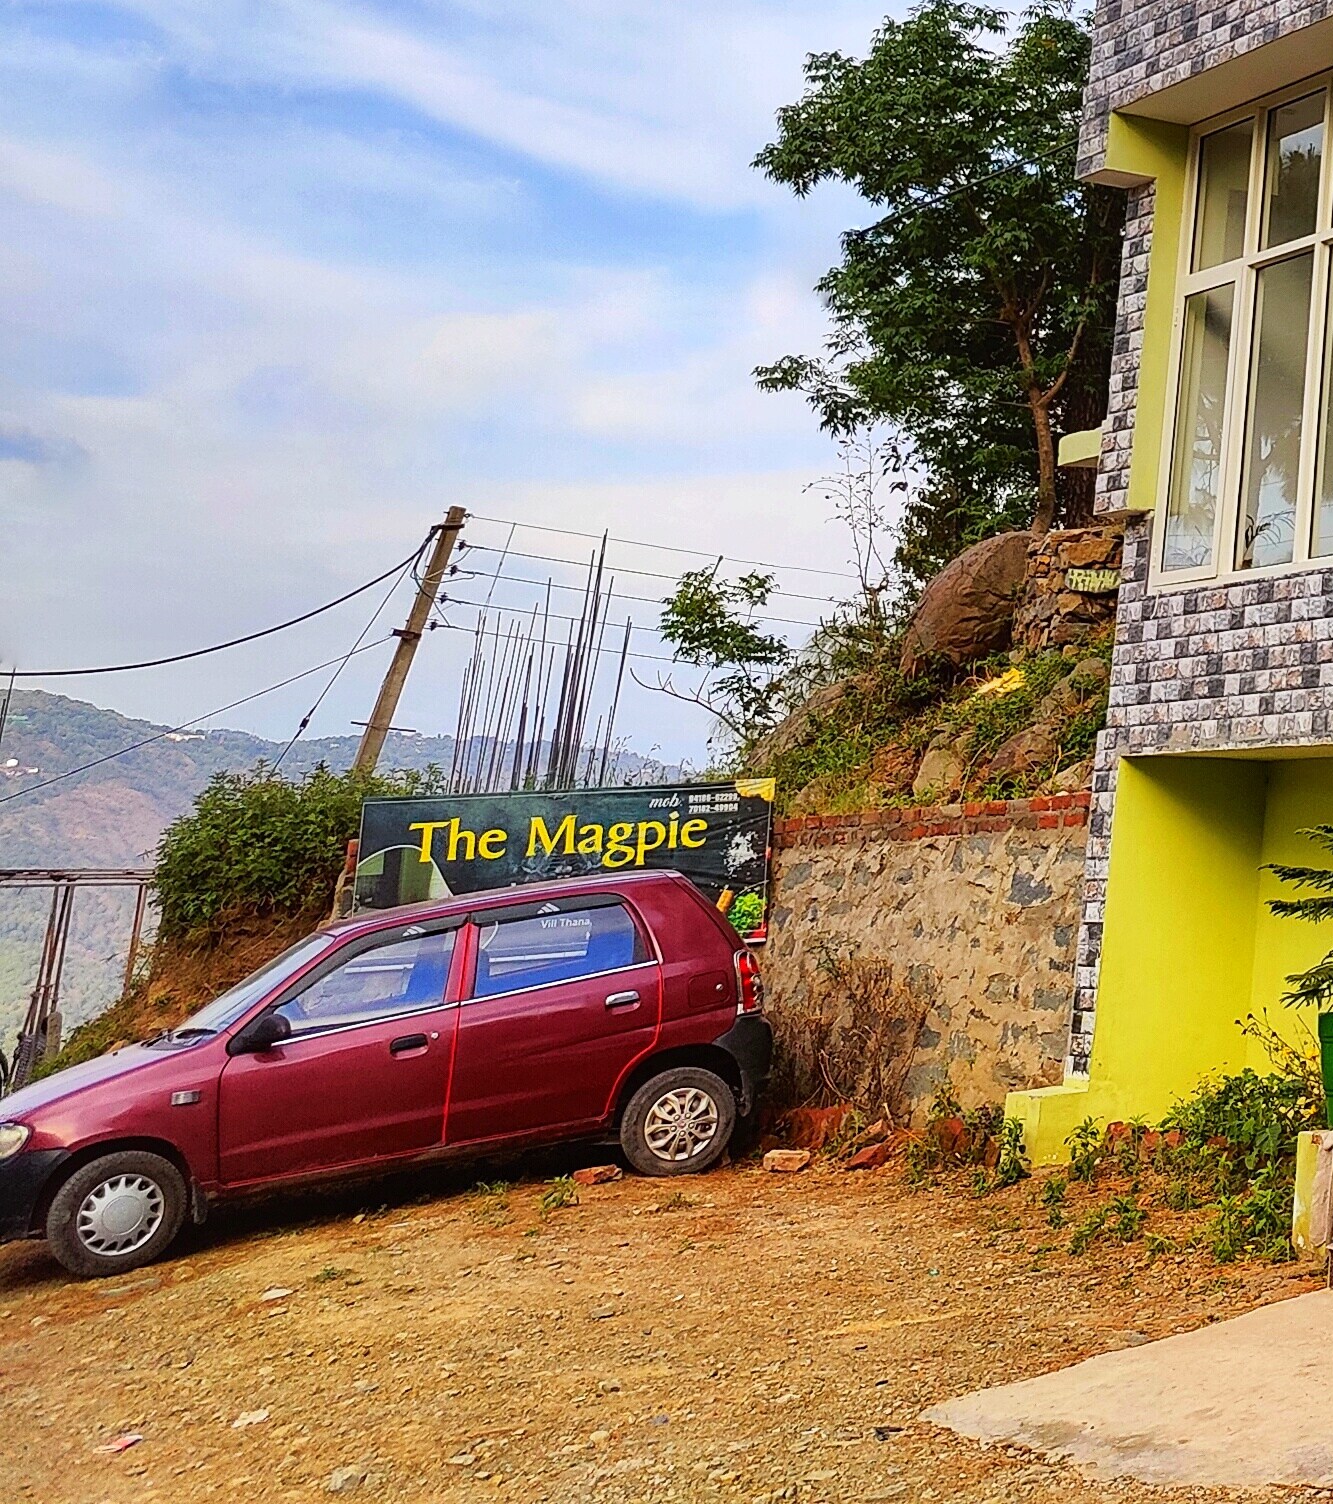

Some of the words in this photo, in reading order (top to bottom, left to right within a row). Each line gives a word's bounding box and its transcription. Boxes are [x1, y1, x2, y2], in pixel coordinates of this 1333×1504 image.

[408, 817, 508, 863] The
[526, 810, 708, 868] Magpie
[541, 919, 557, 929] Vill
